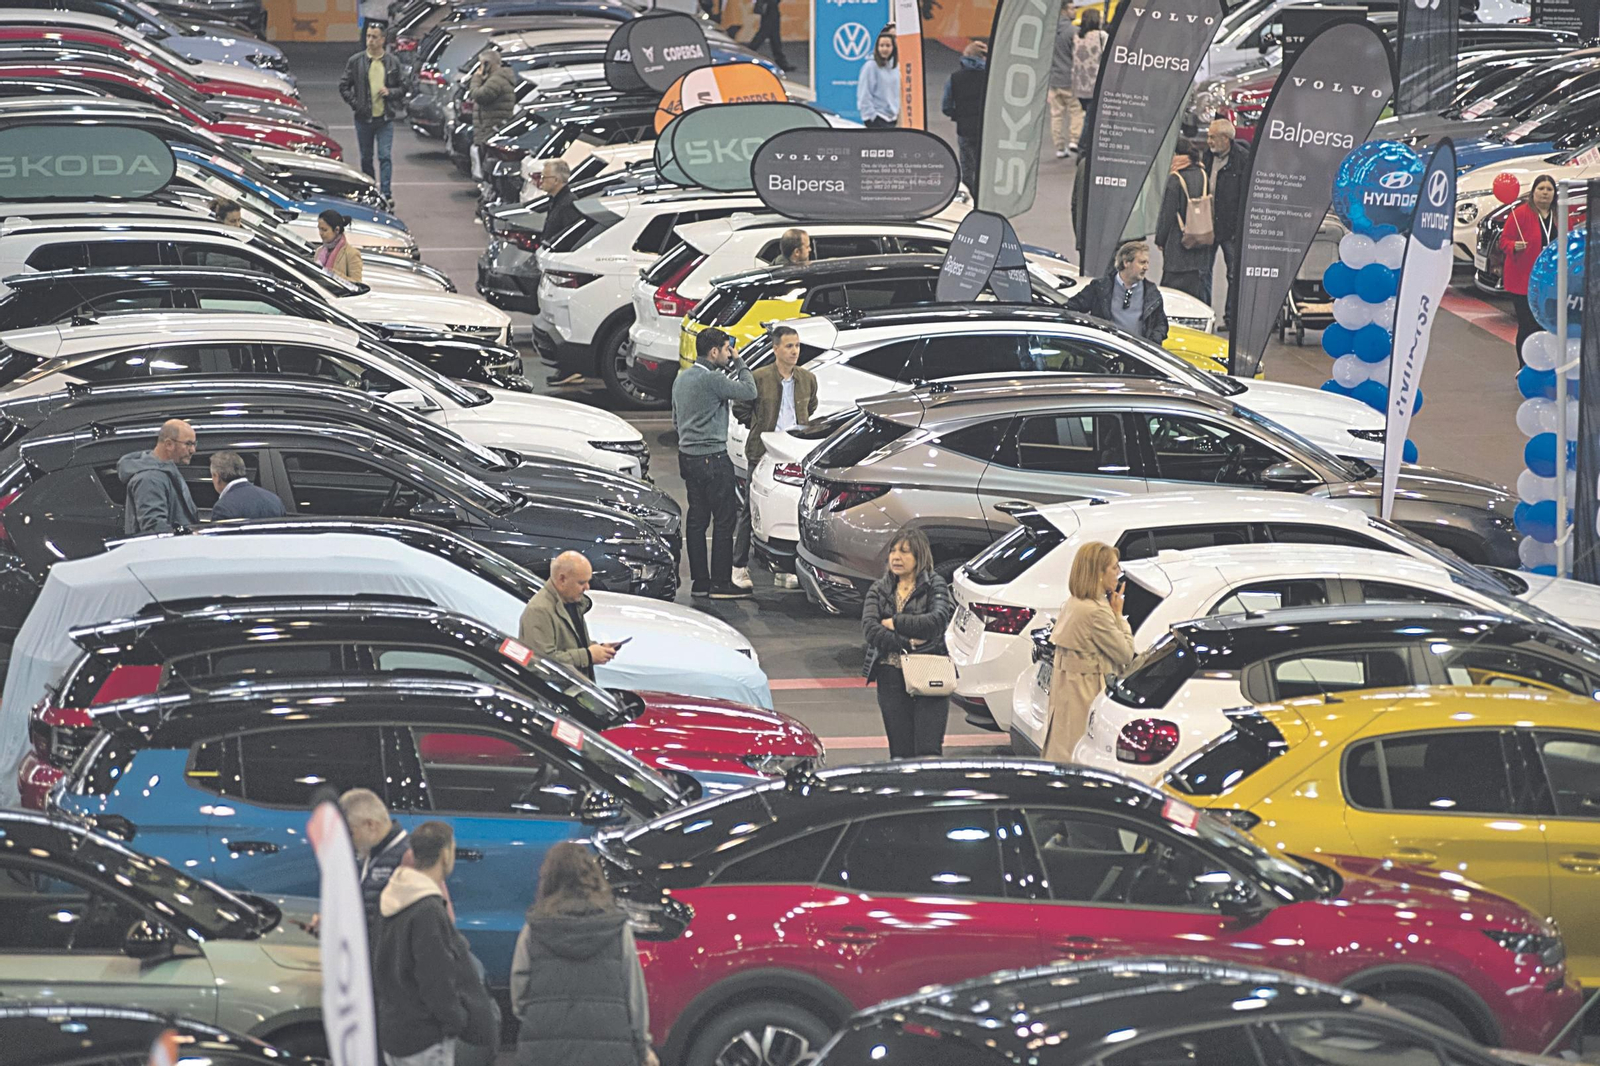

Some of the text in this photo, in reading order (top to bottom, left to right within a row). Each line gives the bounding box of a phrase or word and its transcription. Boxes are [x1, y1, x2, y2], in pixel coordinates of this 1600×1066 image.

[1133, 7, 1214, 25] VOLVO
[663, 44, 704, 62] COPERSA
[1114, 45, 1190, 72] Balpersa
[1293, 76, 1382, 98] VOLVO
[1269, 119, 1354, 149] Balpersa
[775, 153, 839, 161] VOLVO
[769, 174, 845, 195] Balpersa
